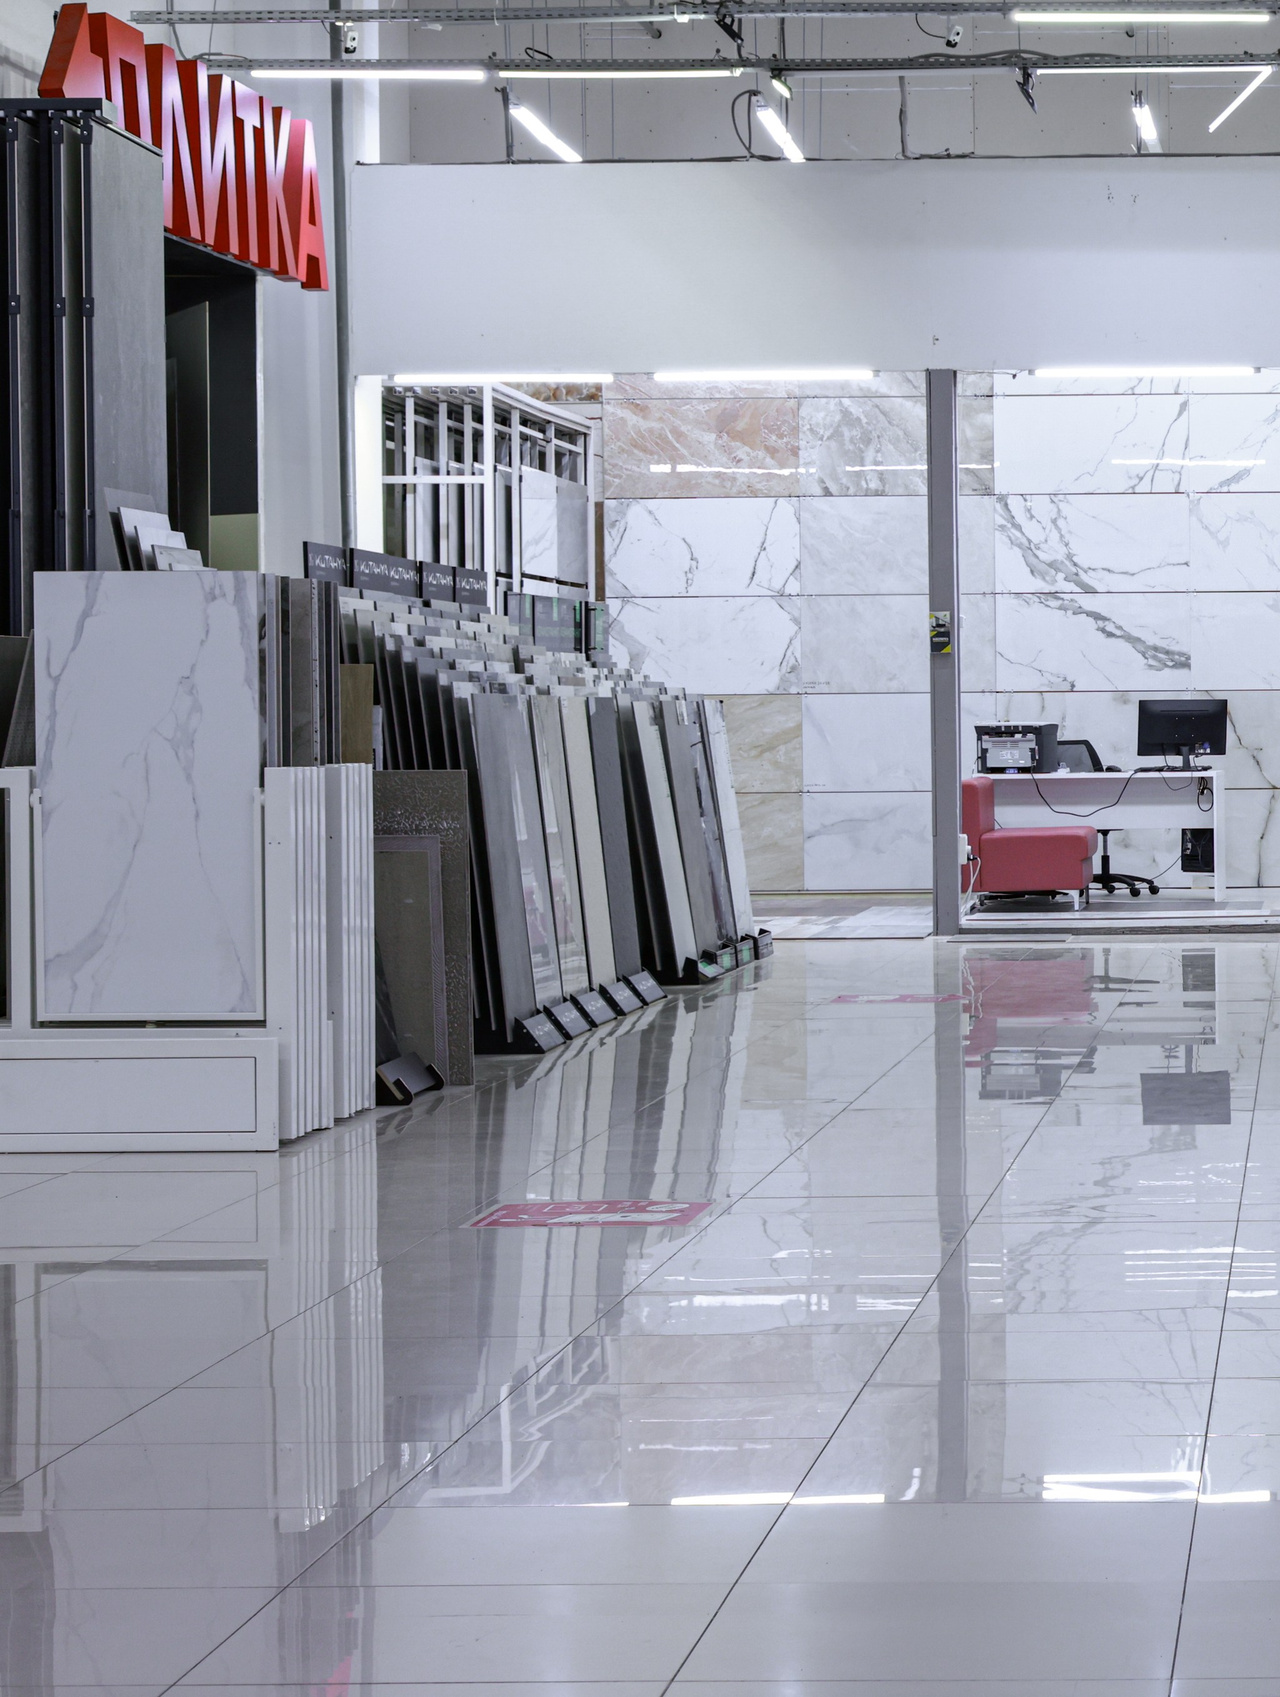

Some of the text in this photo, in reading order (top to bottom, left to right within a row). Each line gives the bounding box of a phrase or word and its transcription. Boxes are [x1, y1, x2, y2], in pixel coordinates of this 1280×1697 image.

[92, 12, 329, 291] ПЛИТКА
[315, 554, 346, 571] KUTAHYA
[360, 559, 389, 577] KUTAHYA
[462, 577, 488, 593] KUTAHYA
